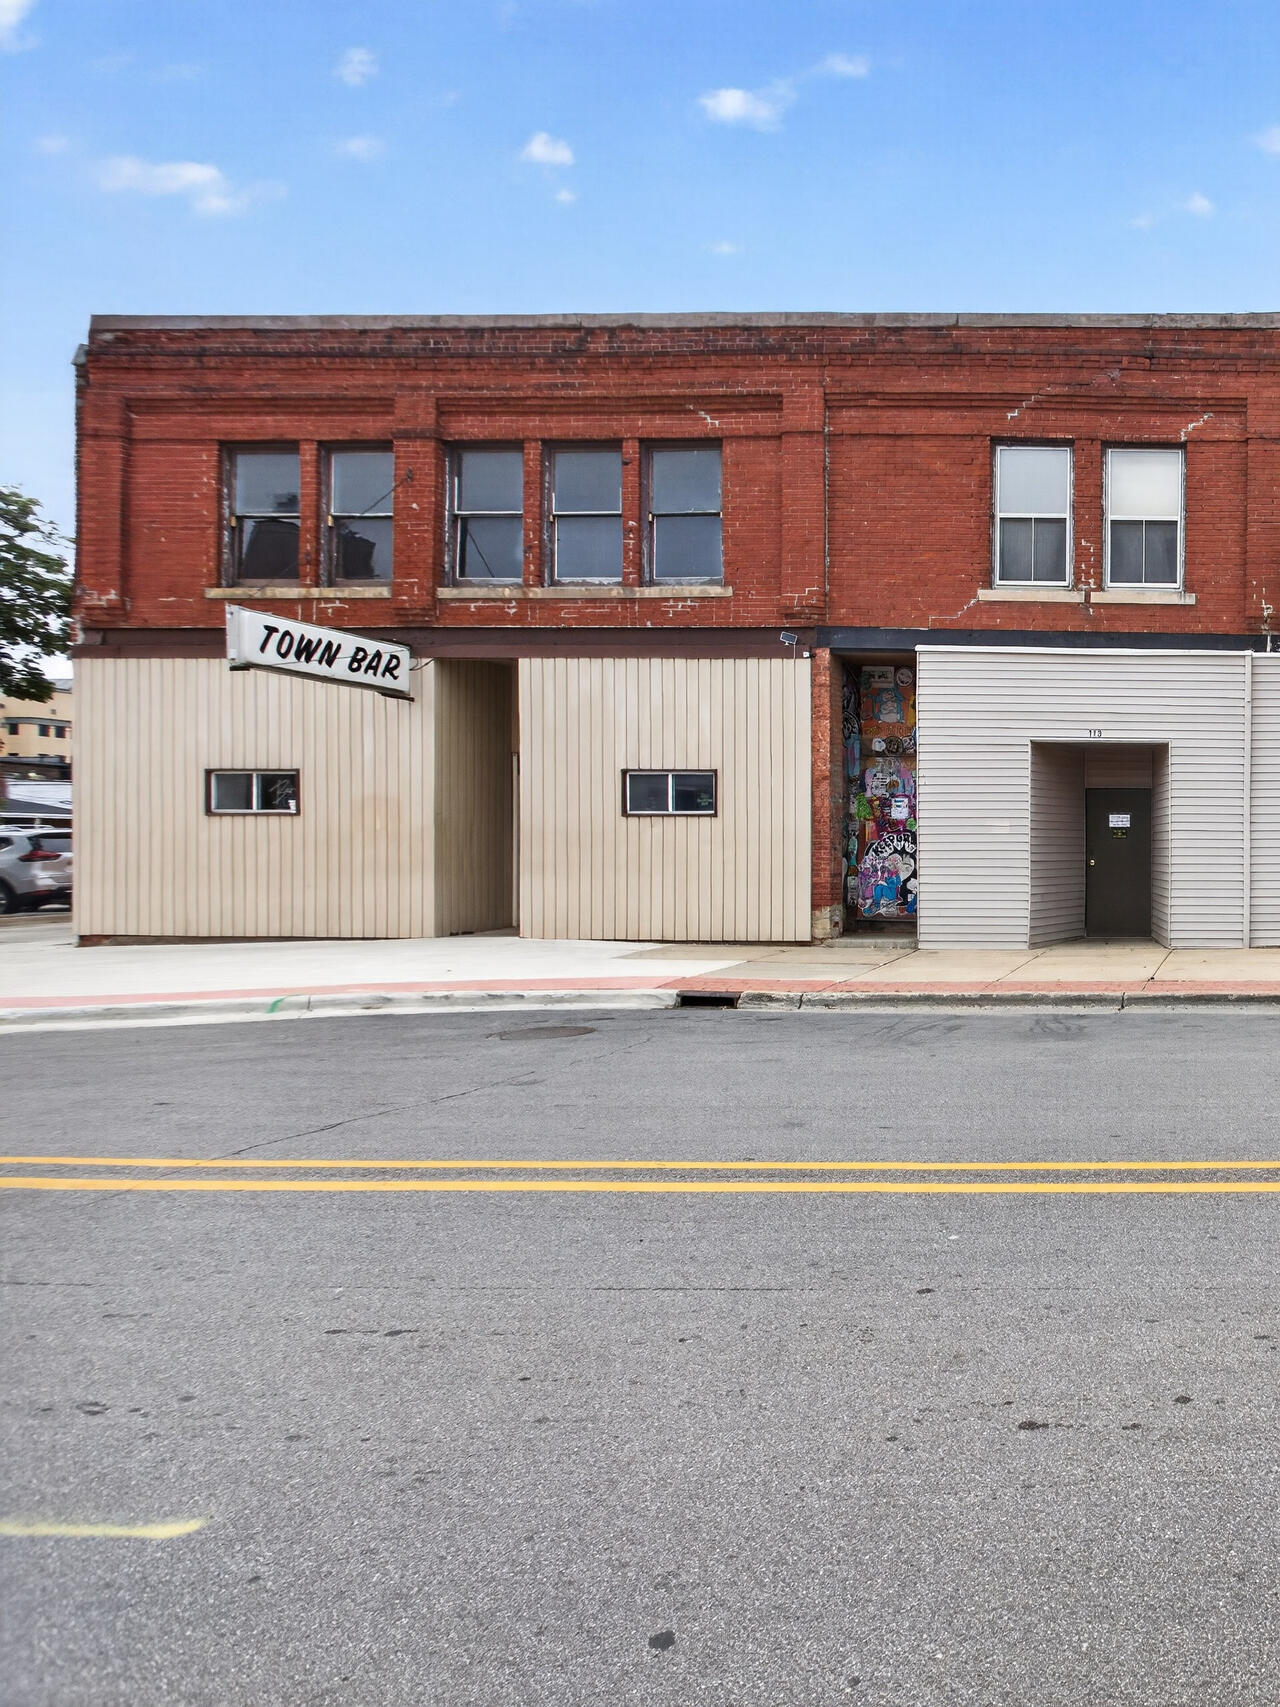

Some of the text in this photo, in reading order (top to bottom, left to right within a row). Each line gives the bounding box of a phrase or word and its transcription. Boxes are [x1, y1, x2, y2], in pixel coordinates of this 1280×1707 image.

[259, 624, 401, 680] TOWN BAR
[1088, 729, 1103, 738] 113
